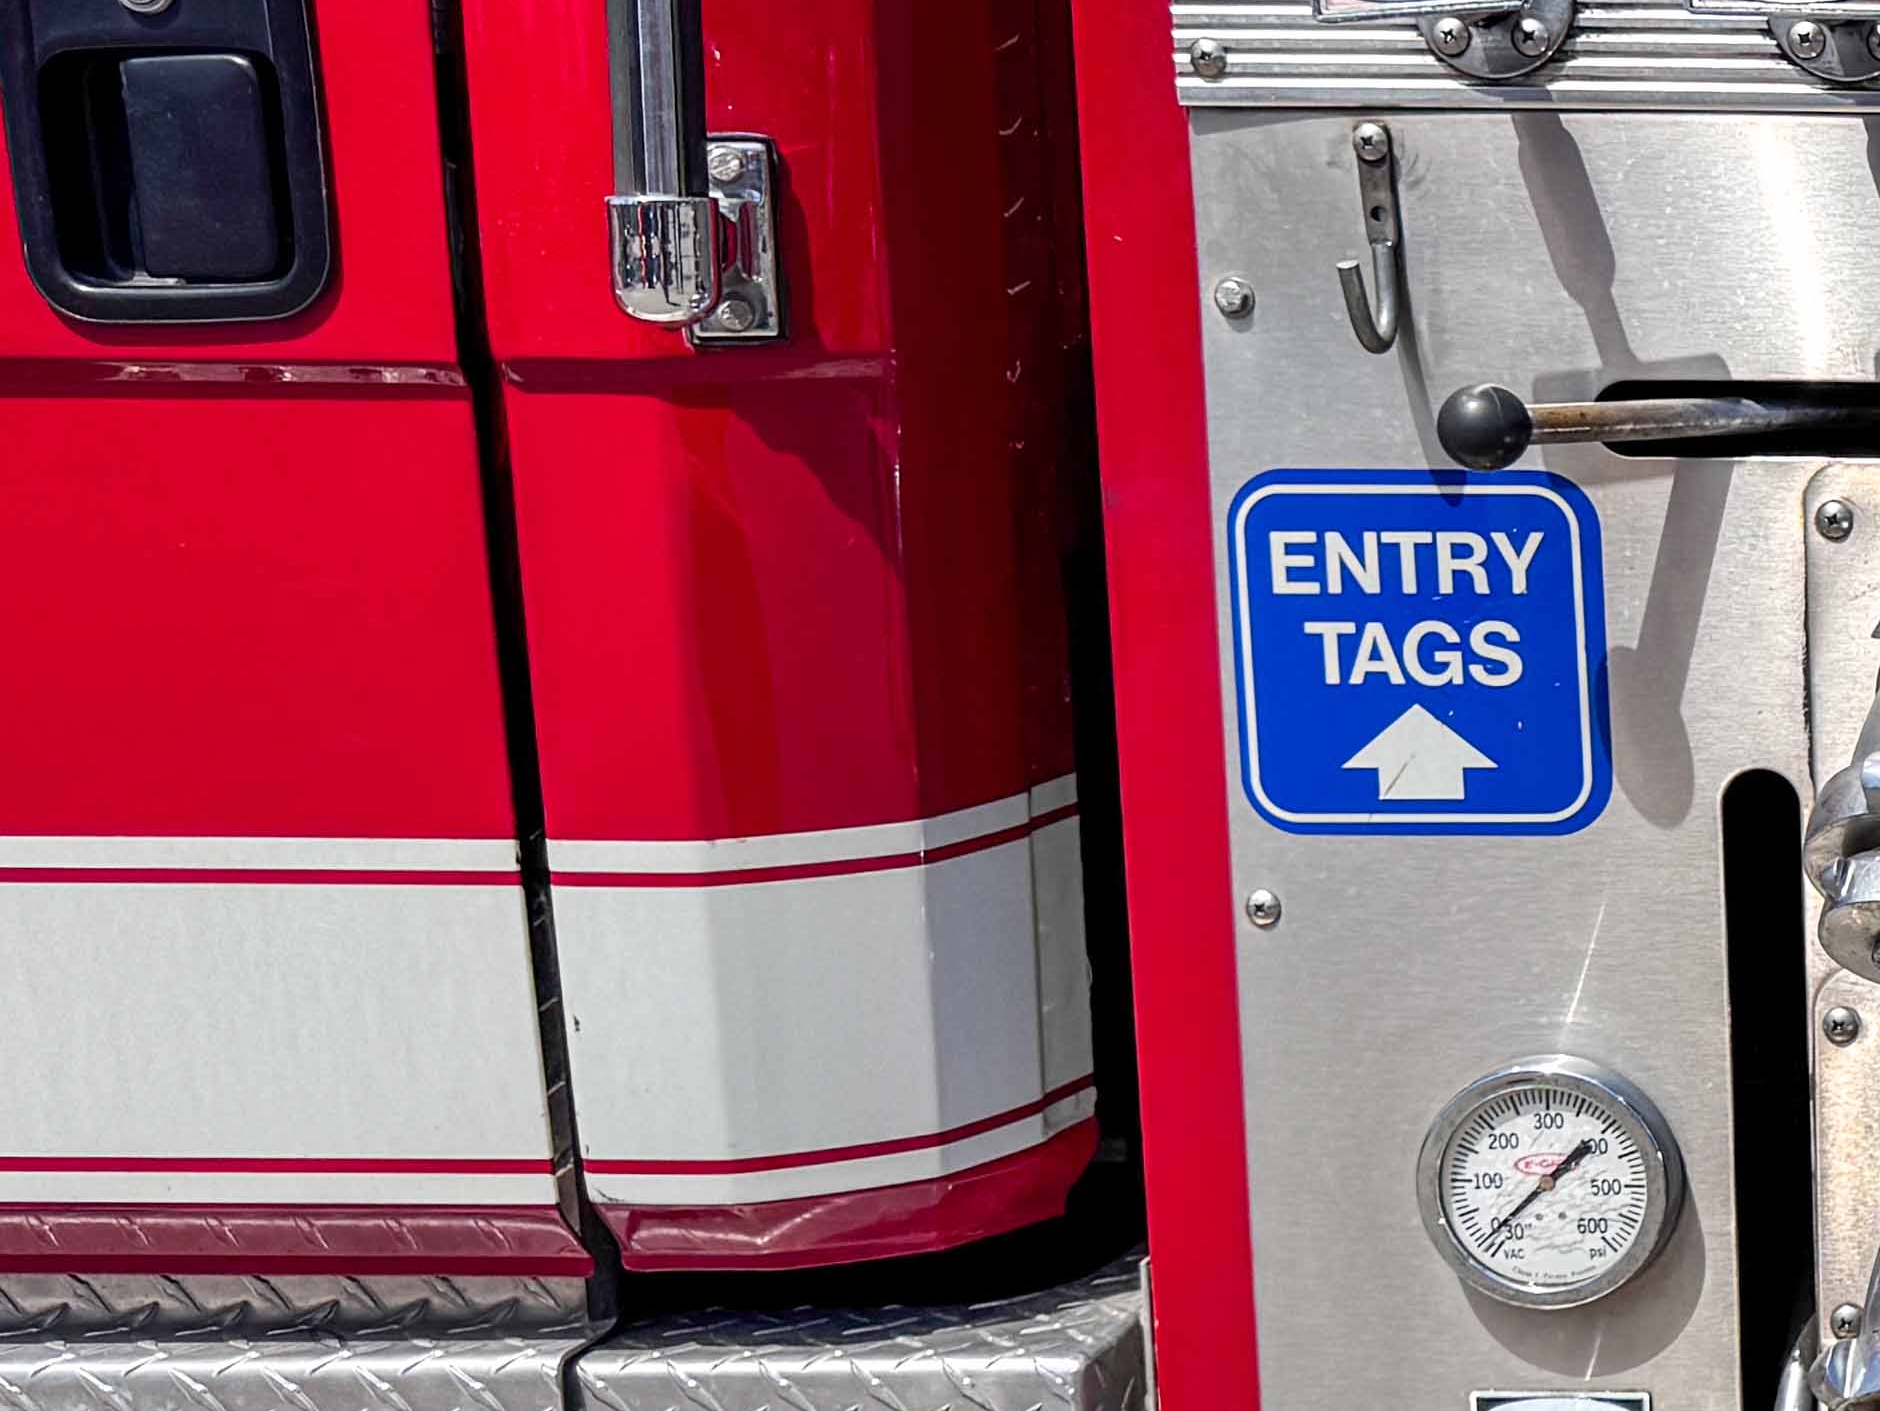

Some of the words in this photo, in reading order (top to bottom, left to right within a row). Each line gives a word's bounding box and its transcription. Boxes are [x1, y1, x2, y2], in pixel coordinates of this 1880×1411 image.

[1269, 530, 1545, 595] ENTRY
[1304, 619, 1524, 687] TAGS
[1533, 1112, 1565, 1130] 300
[1590, 1178, 1622, 1196] 500
